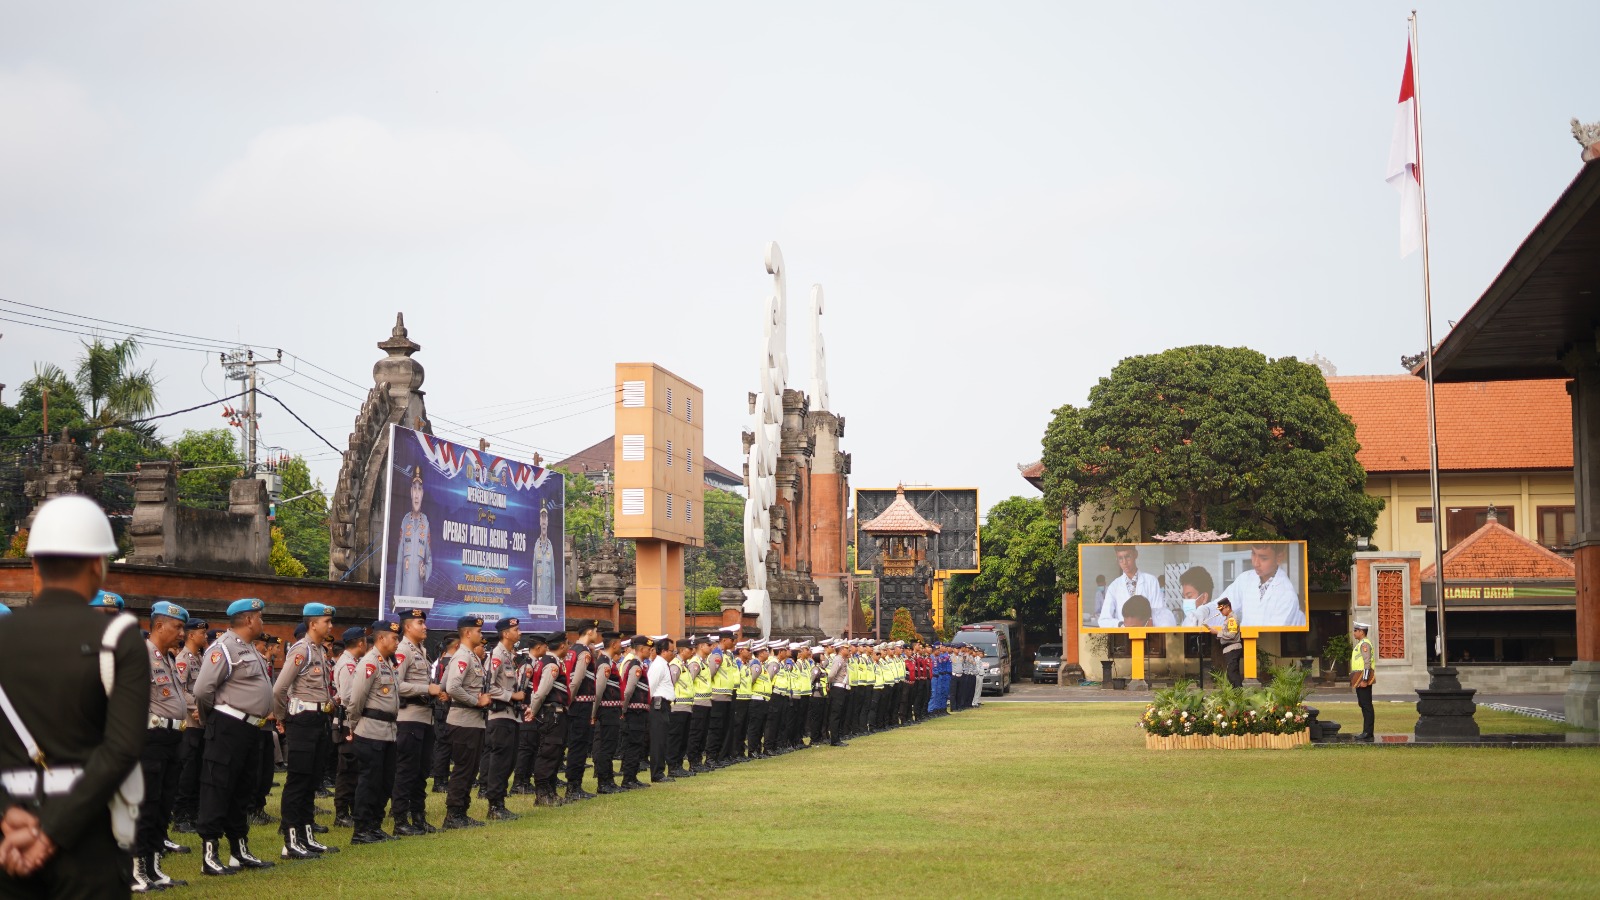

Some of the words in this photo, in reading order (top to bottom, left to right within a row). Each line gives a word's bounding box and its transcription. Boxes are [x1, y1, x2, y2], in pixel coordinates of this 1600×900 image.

[443, 520, 468, 544] OPERASI
[469, 525, 487, 547] PATUH
[489, 528, 508, 549] AGUNG
[1444, 587, 1482, 599] ELAMAT
